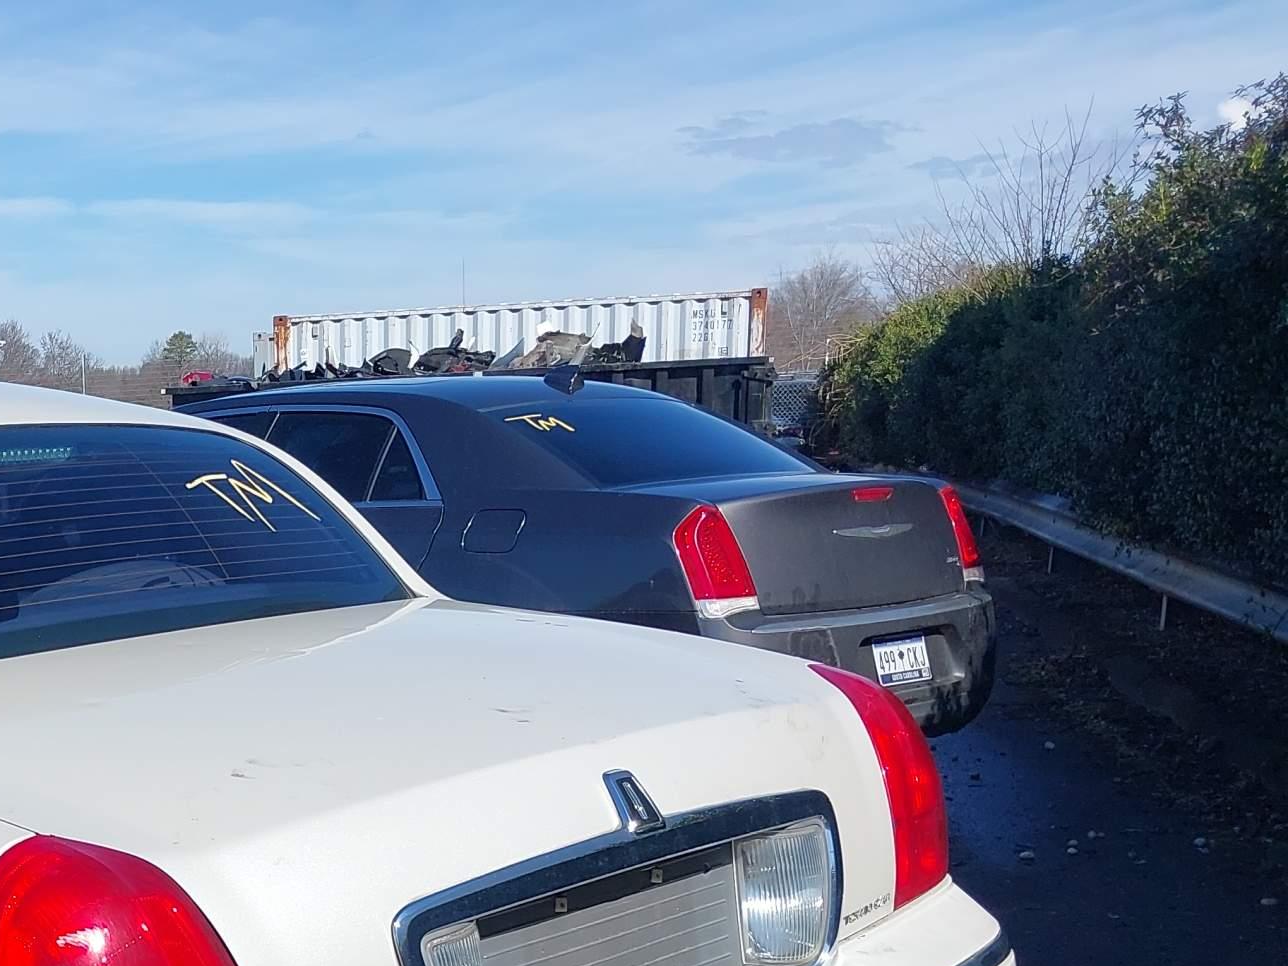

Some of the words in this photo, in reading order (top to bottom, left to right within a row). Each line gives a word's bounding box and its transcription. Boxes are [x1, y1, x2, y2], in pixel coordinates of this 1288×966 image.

[692, 308, 716, 319] MSKU
[692, 319, 733, 331] 3740177
[879, 650, 897, 672] 499
[907, 646, 926, 668] CKJ
